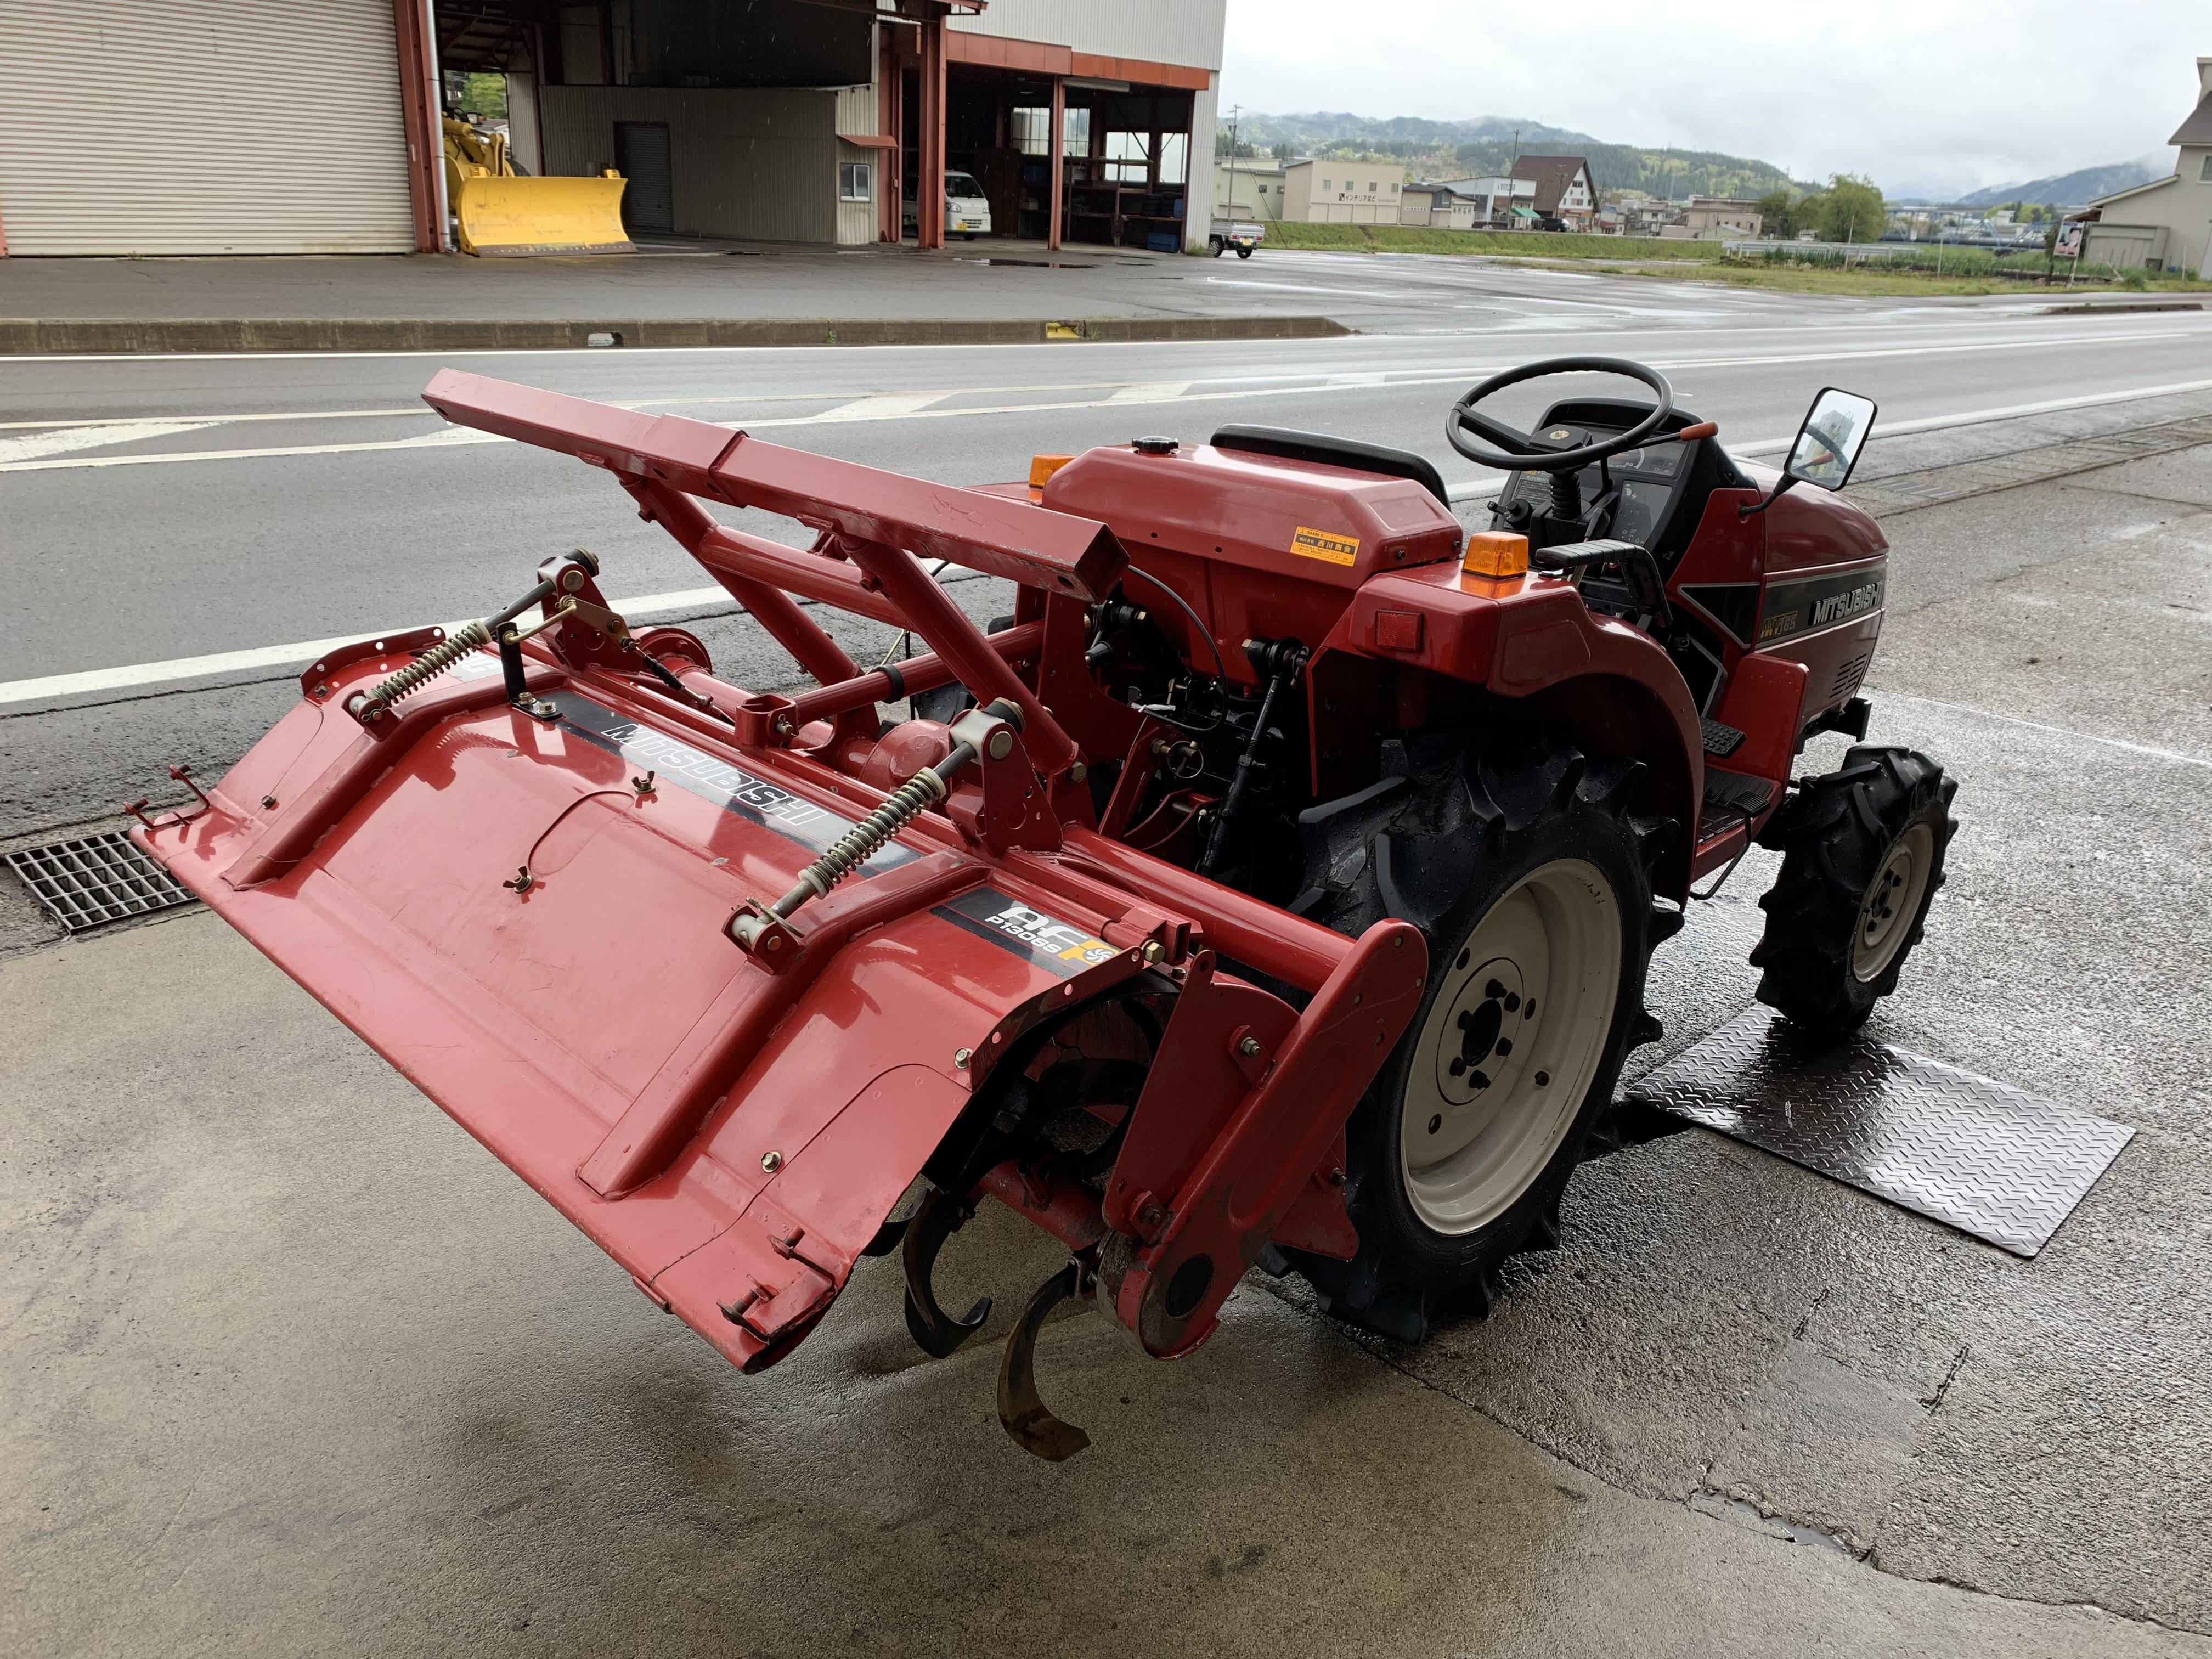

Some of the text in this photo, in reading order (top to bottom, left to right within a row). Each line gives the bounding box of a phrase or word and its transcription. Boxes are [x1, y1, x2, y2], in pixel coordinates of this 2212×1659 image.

[1812, 581, 1883, 627] MITSUBISHI
[601, 723, 829, 826] MITSUBISHI
[984, 915, 1062, 953] P1306S
